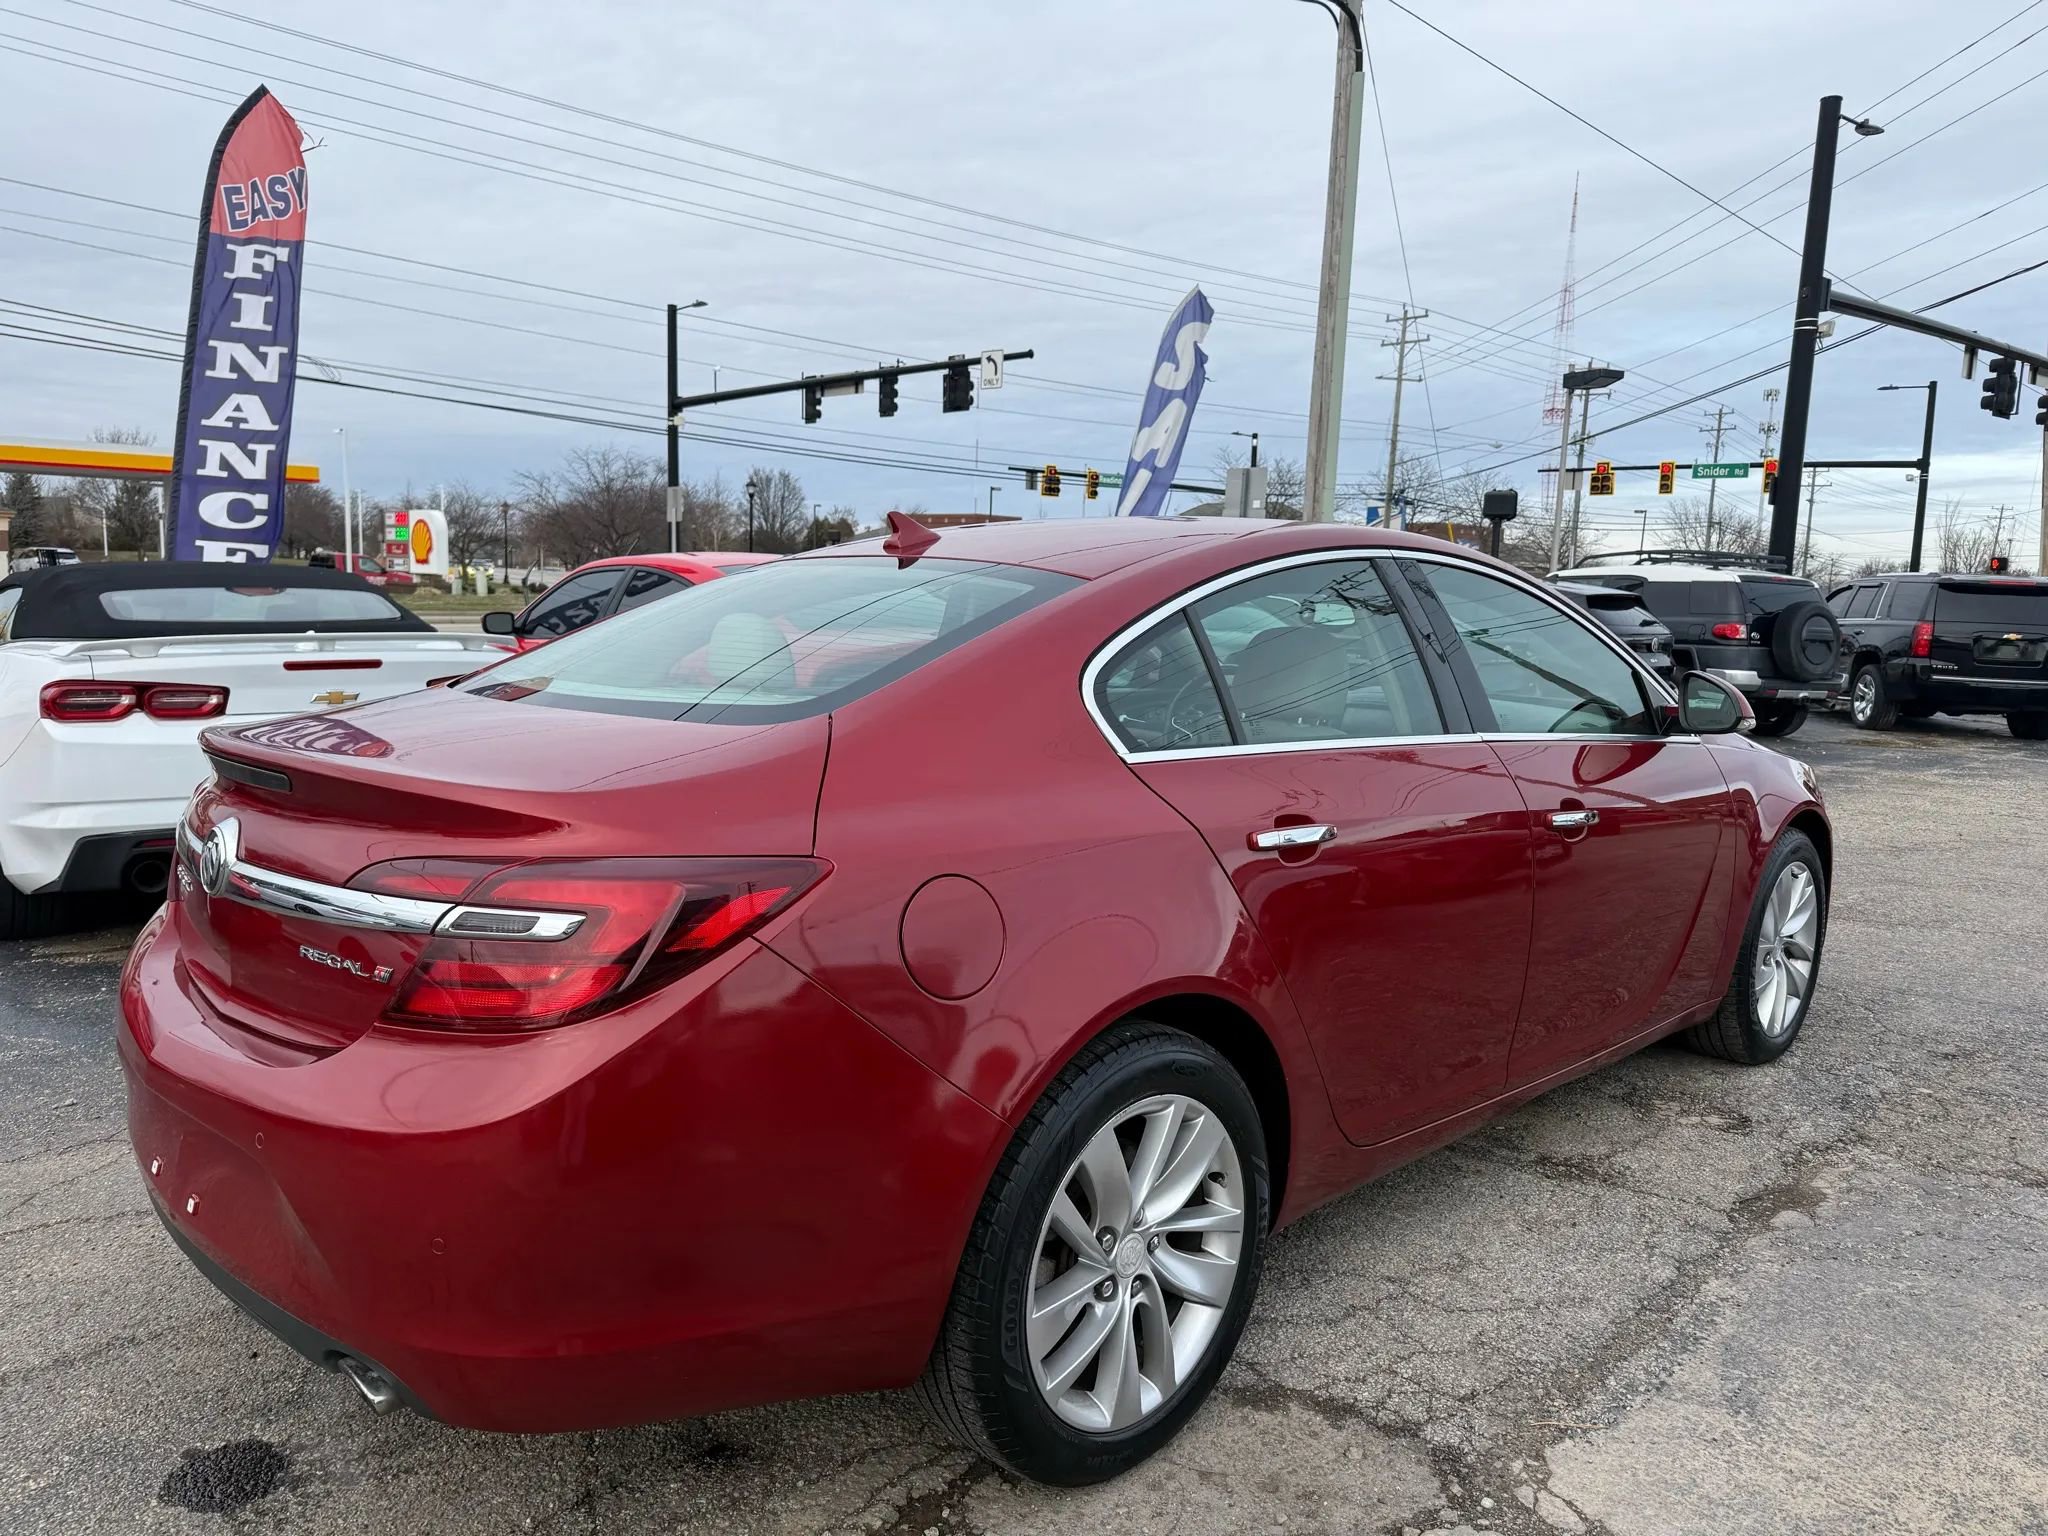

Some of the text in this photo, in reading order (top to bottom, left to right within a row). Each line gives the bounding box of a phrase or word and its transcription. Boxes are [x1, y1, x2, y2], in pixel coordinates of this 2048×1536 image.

[221, 166, 306, 232] EASY
[983, 378, 999, 387] ONLY
[1697, 466, 1730, 476] Snider
[299, 945, 370, 977] REGAL
